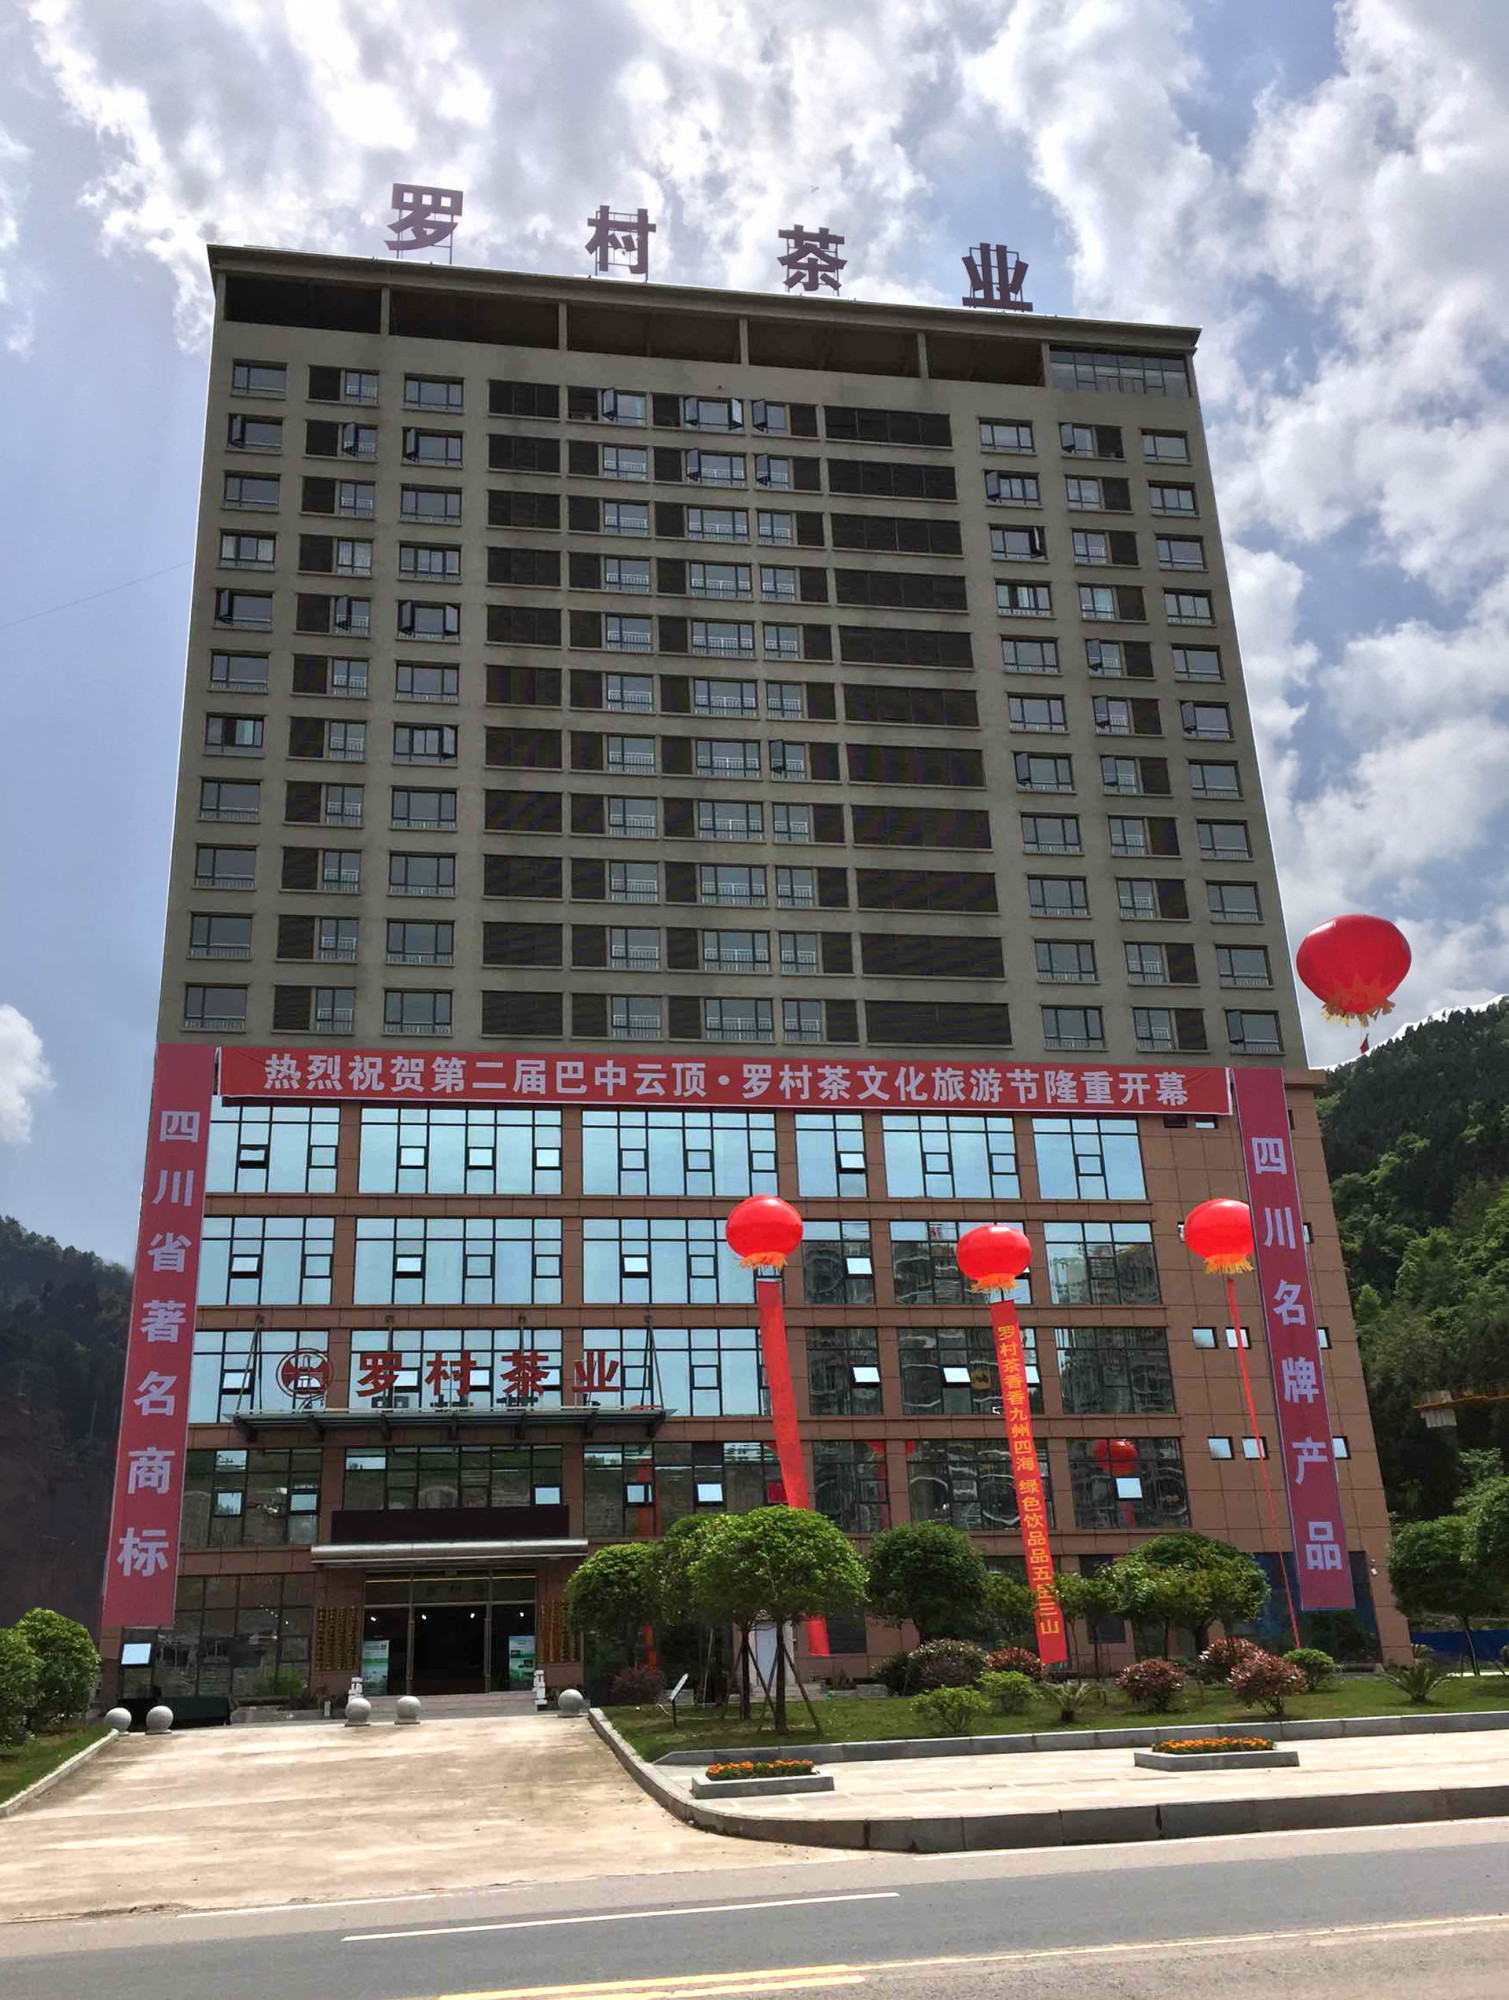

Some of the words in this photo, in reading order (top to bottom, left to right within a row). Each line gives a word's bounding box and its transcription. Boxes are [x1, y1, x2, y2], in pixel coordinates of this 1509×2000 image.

[384, 183, 1033, 312] 罗村茶业
[264, 1053, 1189, 1107] 热烈祝贺第二届巴中云顶·罗村茶文化旅游节隆重开幕
[116, 1109, 201, 1577] 四川省著名商标
[357, 1349, 622, 1397] 罗村茶业
[1251, 1137, 1343, 1571] 四川名牌产品
